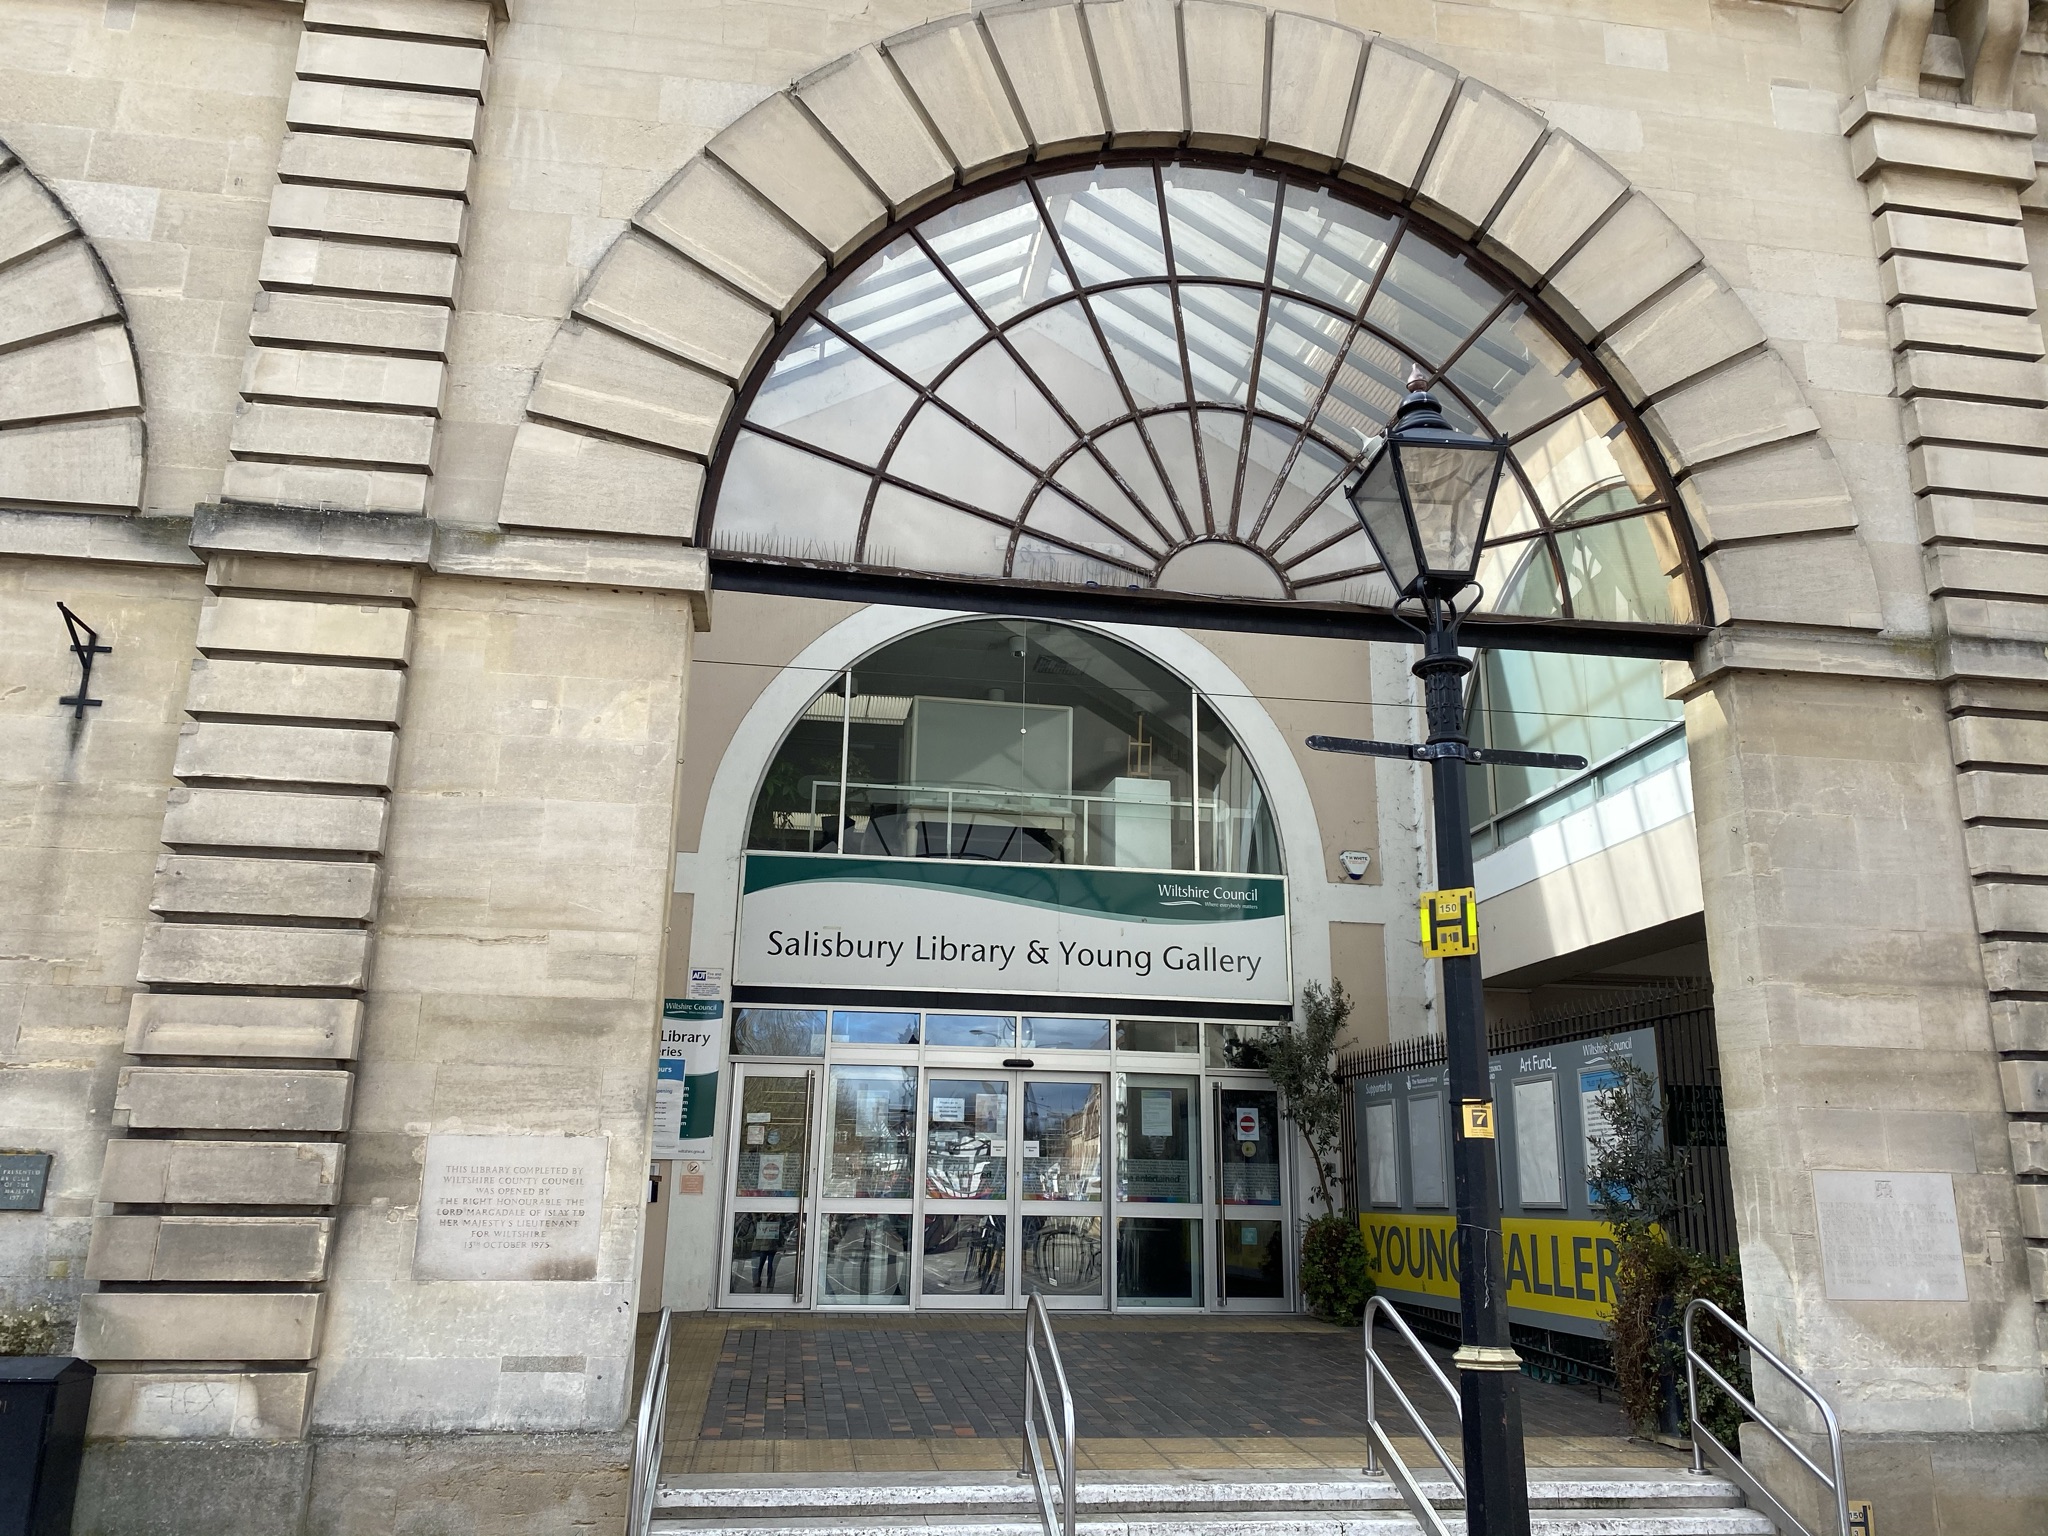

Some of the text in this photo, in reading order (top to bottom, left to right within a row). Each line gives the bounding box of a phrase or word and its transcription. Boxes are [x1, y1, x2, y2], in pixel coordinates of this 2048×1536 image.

[1158, 884, 1258, 901] Wiltshire Council
[1440, 904, 1457, 913] 150
[767, 931, 1262, 981] Salisbury Library & Young Gallery
[693, 972, 706, 980] ADT
[660, 1030, 711, 1047] Library
[660, 1047, 682, 1056] ries
[1582, 1043, 1608, 1056] Wiltshire
[1520, 1057, 1531, 1072] Art
[1366, 1081, 1393, 1096] Supported by
[1473, 1112, 1486, 1125] 7
[471, 1166, 510, 1174] LIBRARY
[513, 1167, 568, 1175] COMPLETED
[572, 1167, 583, 1175] BY
[443, 1176, 584, 1186] WILTSHIRE COUNTY COUNCIL
[476, 1187, 495, 1195] WAS
[498, 1187, 535, 1195] OPENED
[440, 1197, 584, 1206] THE RIGHT HONOURABLE THE
[437, 1208, 463, 1216] LORD
[467, 1208, 525, 1216] MARGADALE
[530, 1209, 541, 1217] OF
[545, 1209, 569, 1217] ISLAY
[439, 1219, 579, 1228] HER MAJESTYS LIEUTENANT
[471, 1230, 547, 1238] FOR WILTSHIRE
[483, 1241, 527, 1249] OCTOBER
[531, 1241, 550, 1249] 1975
[1506, 1233, 1619, 1303] ALLER
[1849, 1511, 1864, 1519] 150
